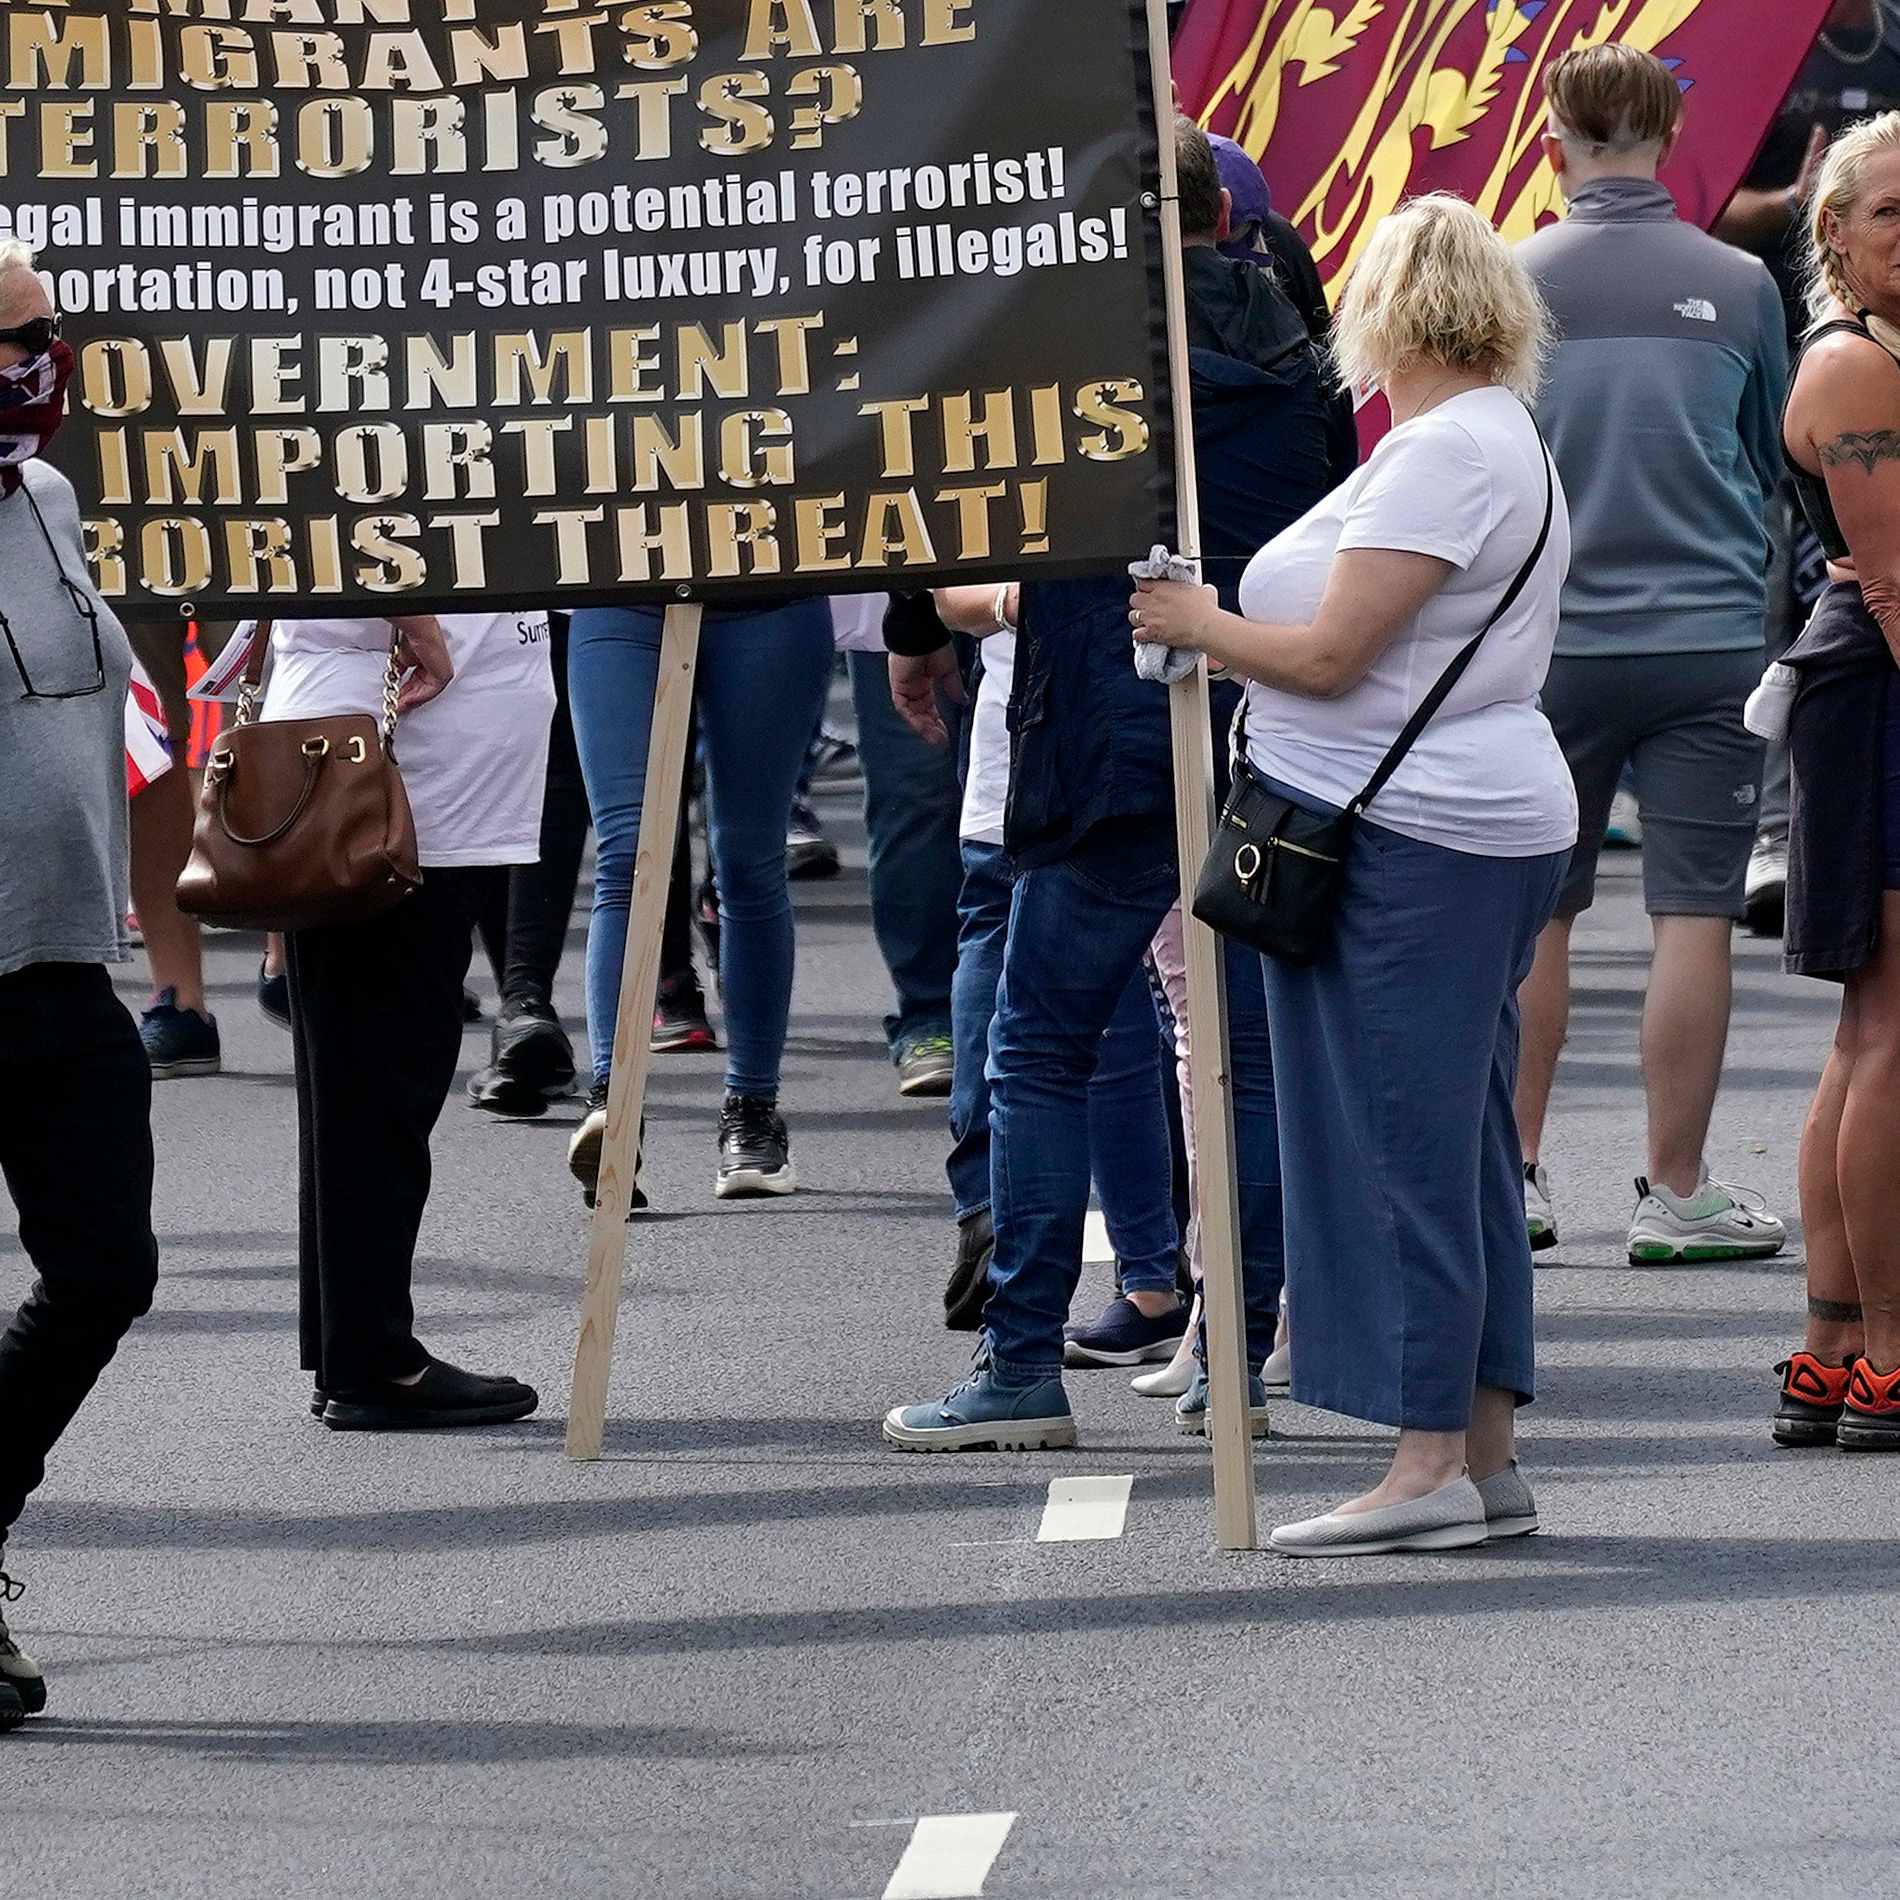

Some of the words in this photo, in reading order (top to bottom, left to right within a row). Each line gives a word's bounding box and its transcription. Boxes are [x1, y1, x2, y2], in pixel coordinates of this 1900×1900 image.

[119, 196, 414, 254] immigrant
[430, 193, 479, 244] is
[496, 196, 527, 242] a
[544, 170, 796, 244] potential
[812, 146, 1067, 221] terrorist!
[315, 262, 407, 312] not
[421, 256, 588, 310] 4-star
[604, 246, 790, 301] luxury,
[805, 234, 882, 288] for
[898, 207, 1129, 280] illegals!
[66, 311, 860, 418] OVERNMENT:
[98, 407, 795, 505] IMPORTING
[857, 377, 1150, 478] THIS
[80, 508, 500, 596] RORIST
[532, 476, 1051, 587] THREAT!
